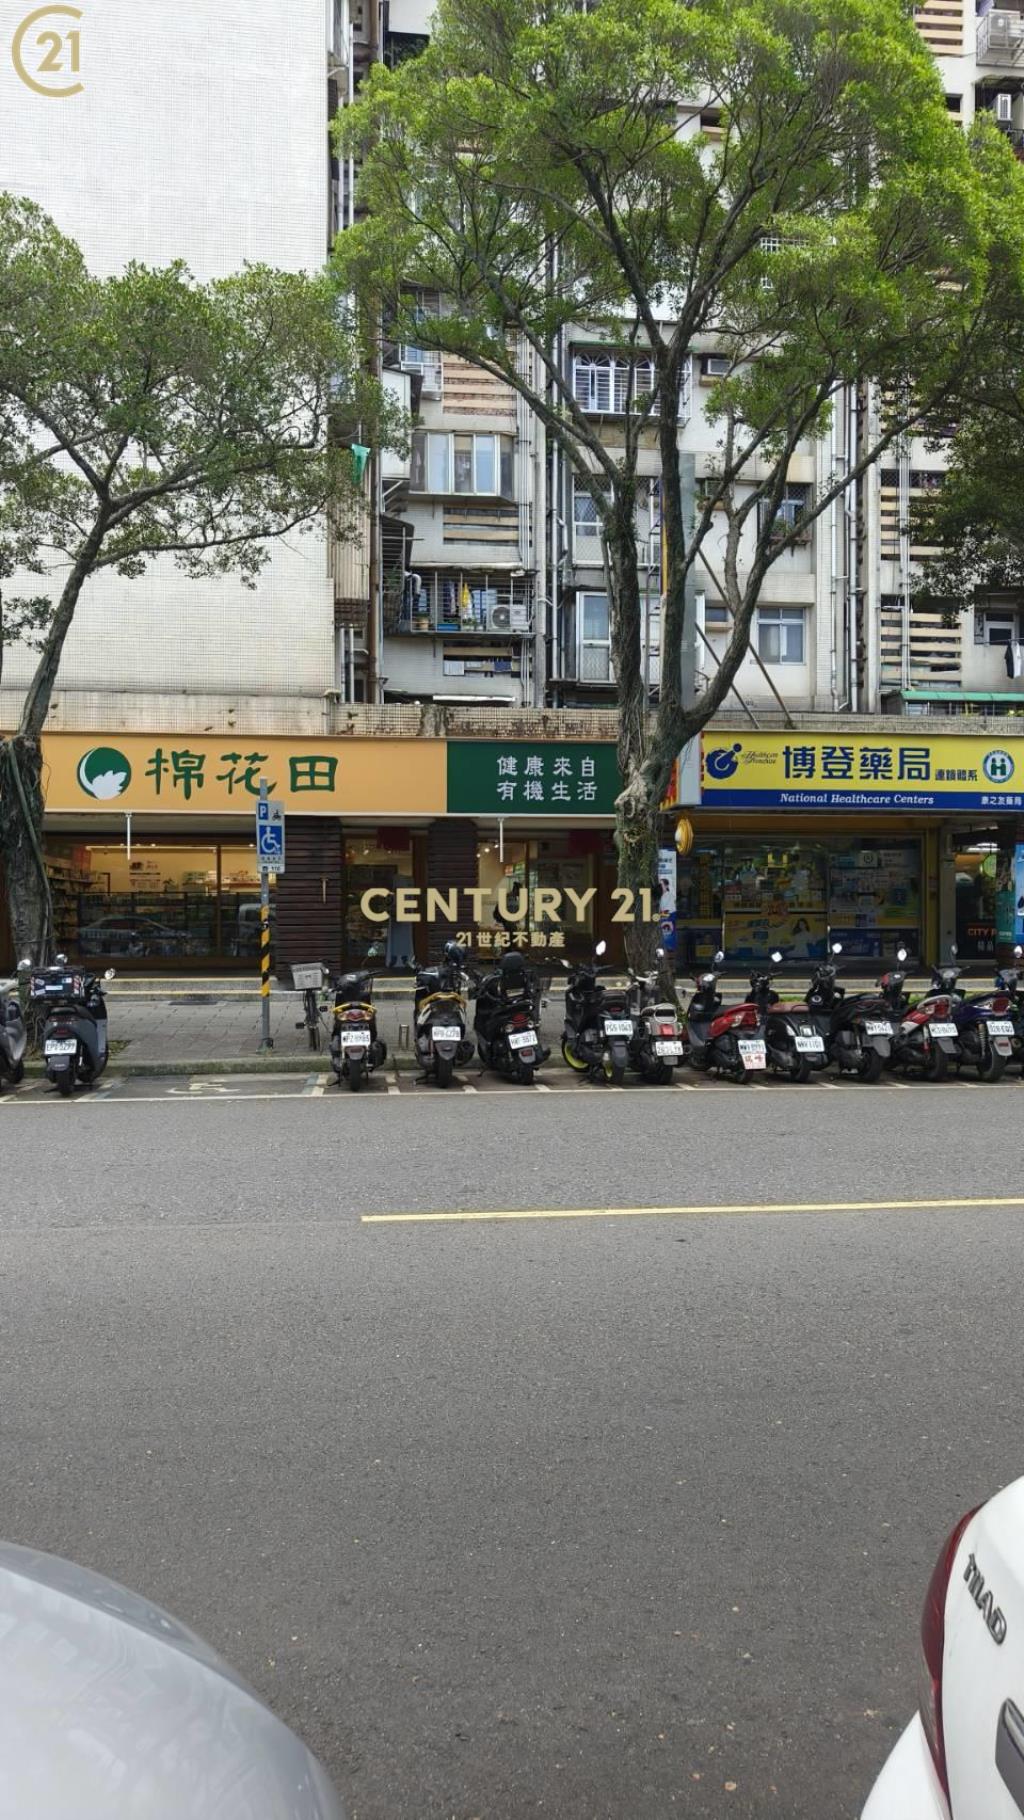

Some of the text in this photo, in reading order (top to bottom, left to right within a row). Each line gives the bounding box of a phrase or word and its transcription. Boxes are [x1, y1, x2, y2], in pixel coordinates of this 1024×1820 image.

[145, 747, 339, 801] 棉花田
[497, 755, 597, 777] 健康來自
[782, 746, 930, 781] 博登藥局
[496, 780, 598, 801] 有機生活
[780, 793, 934, 805] National Healthcare Centers
